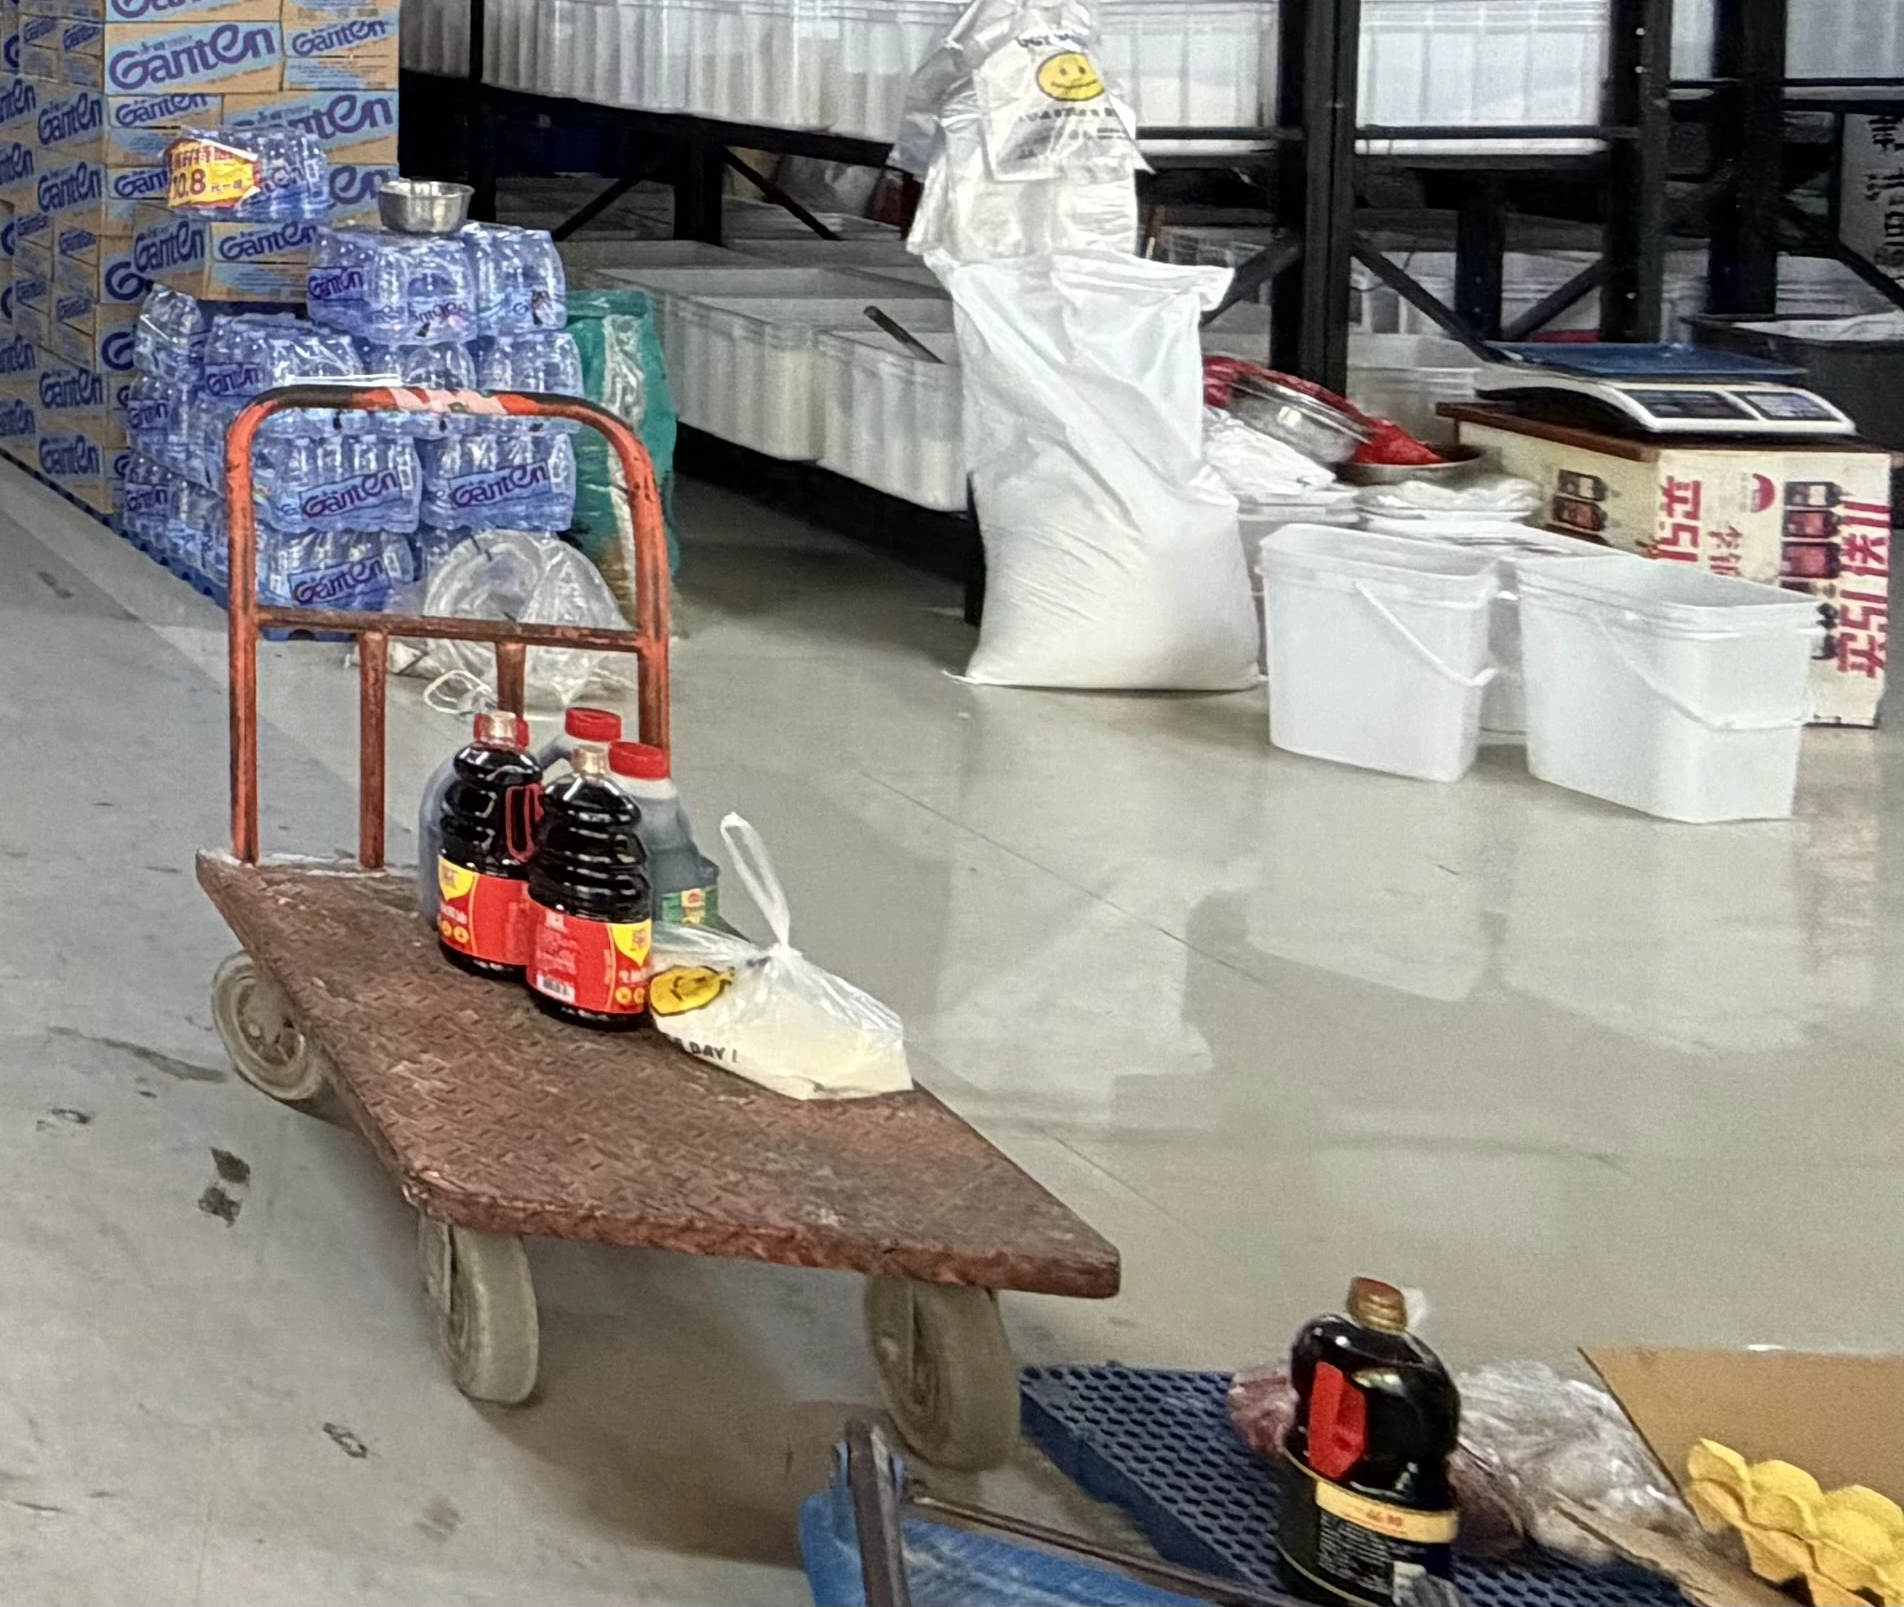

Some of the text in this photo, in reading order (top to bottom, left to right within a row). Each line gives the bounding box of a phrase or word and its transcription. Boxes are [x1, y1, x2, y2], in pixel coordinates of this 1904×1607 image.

[111, 24, 276, 90] Ganten
[292, 20, 386, 57] Ganten
[38, 92, 103, 145] Ganten
[115, 93, 209, 128] Ganten
[38, 161, 101, 211] Ganten
[134, 220, 205, 274] Ganten
[219, 222, 317, 262] Ganten
[40, 368, 103, 408] Ganten
[40, 434, 101, 475] Ganten
[302, 470, 399, 517] Ganten
[451, 462, 547, 508] Ganten
[294, 557, 383, 603] Ganten
